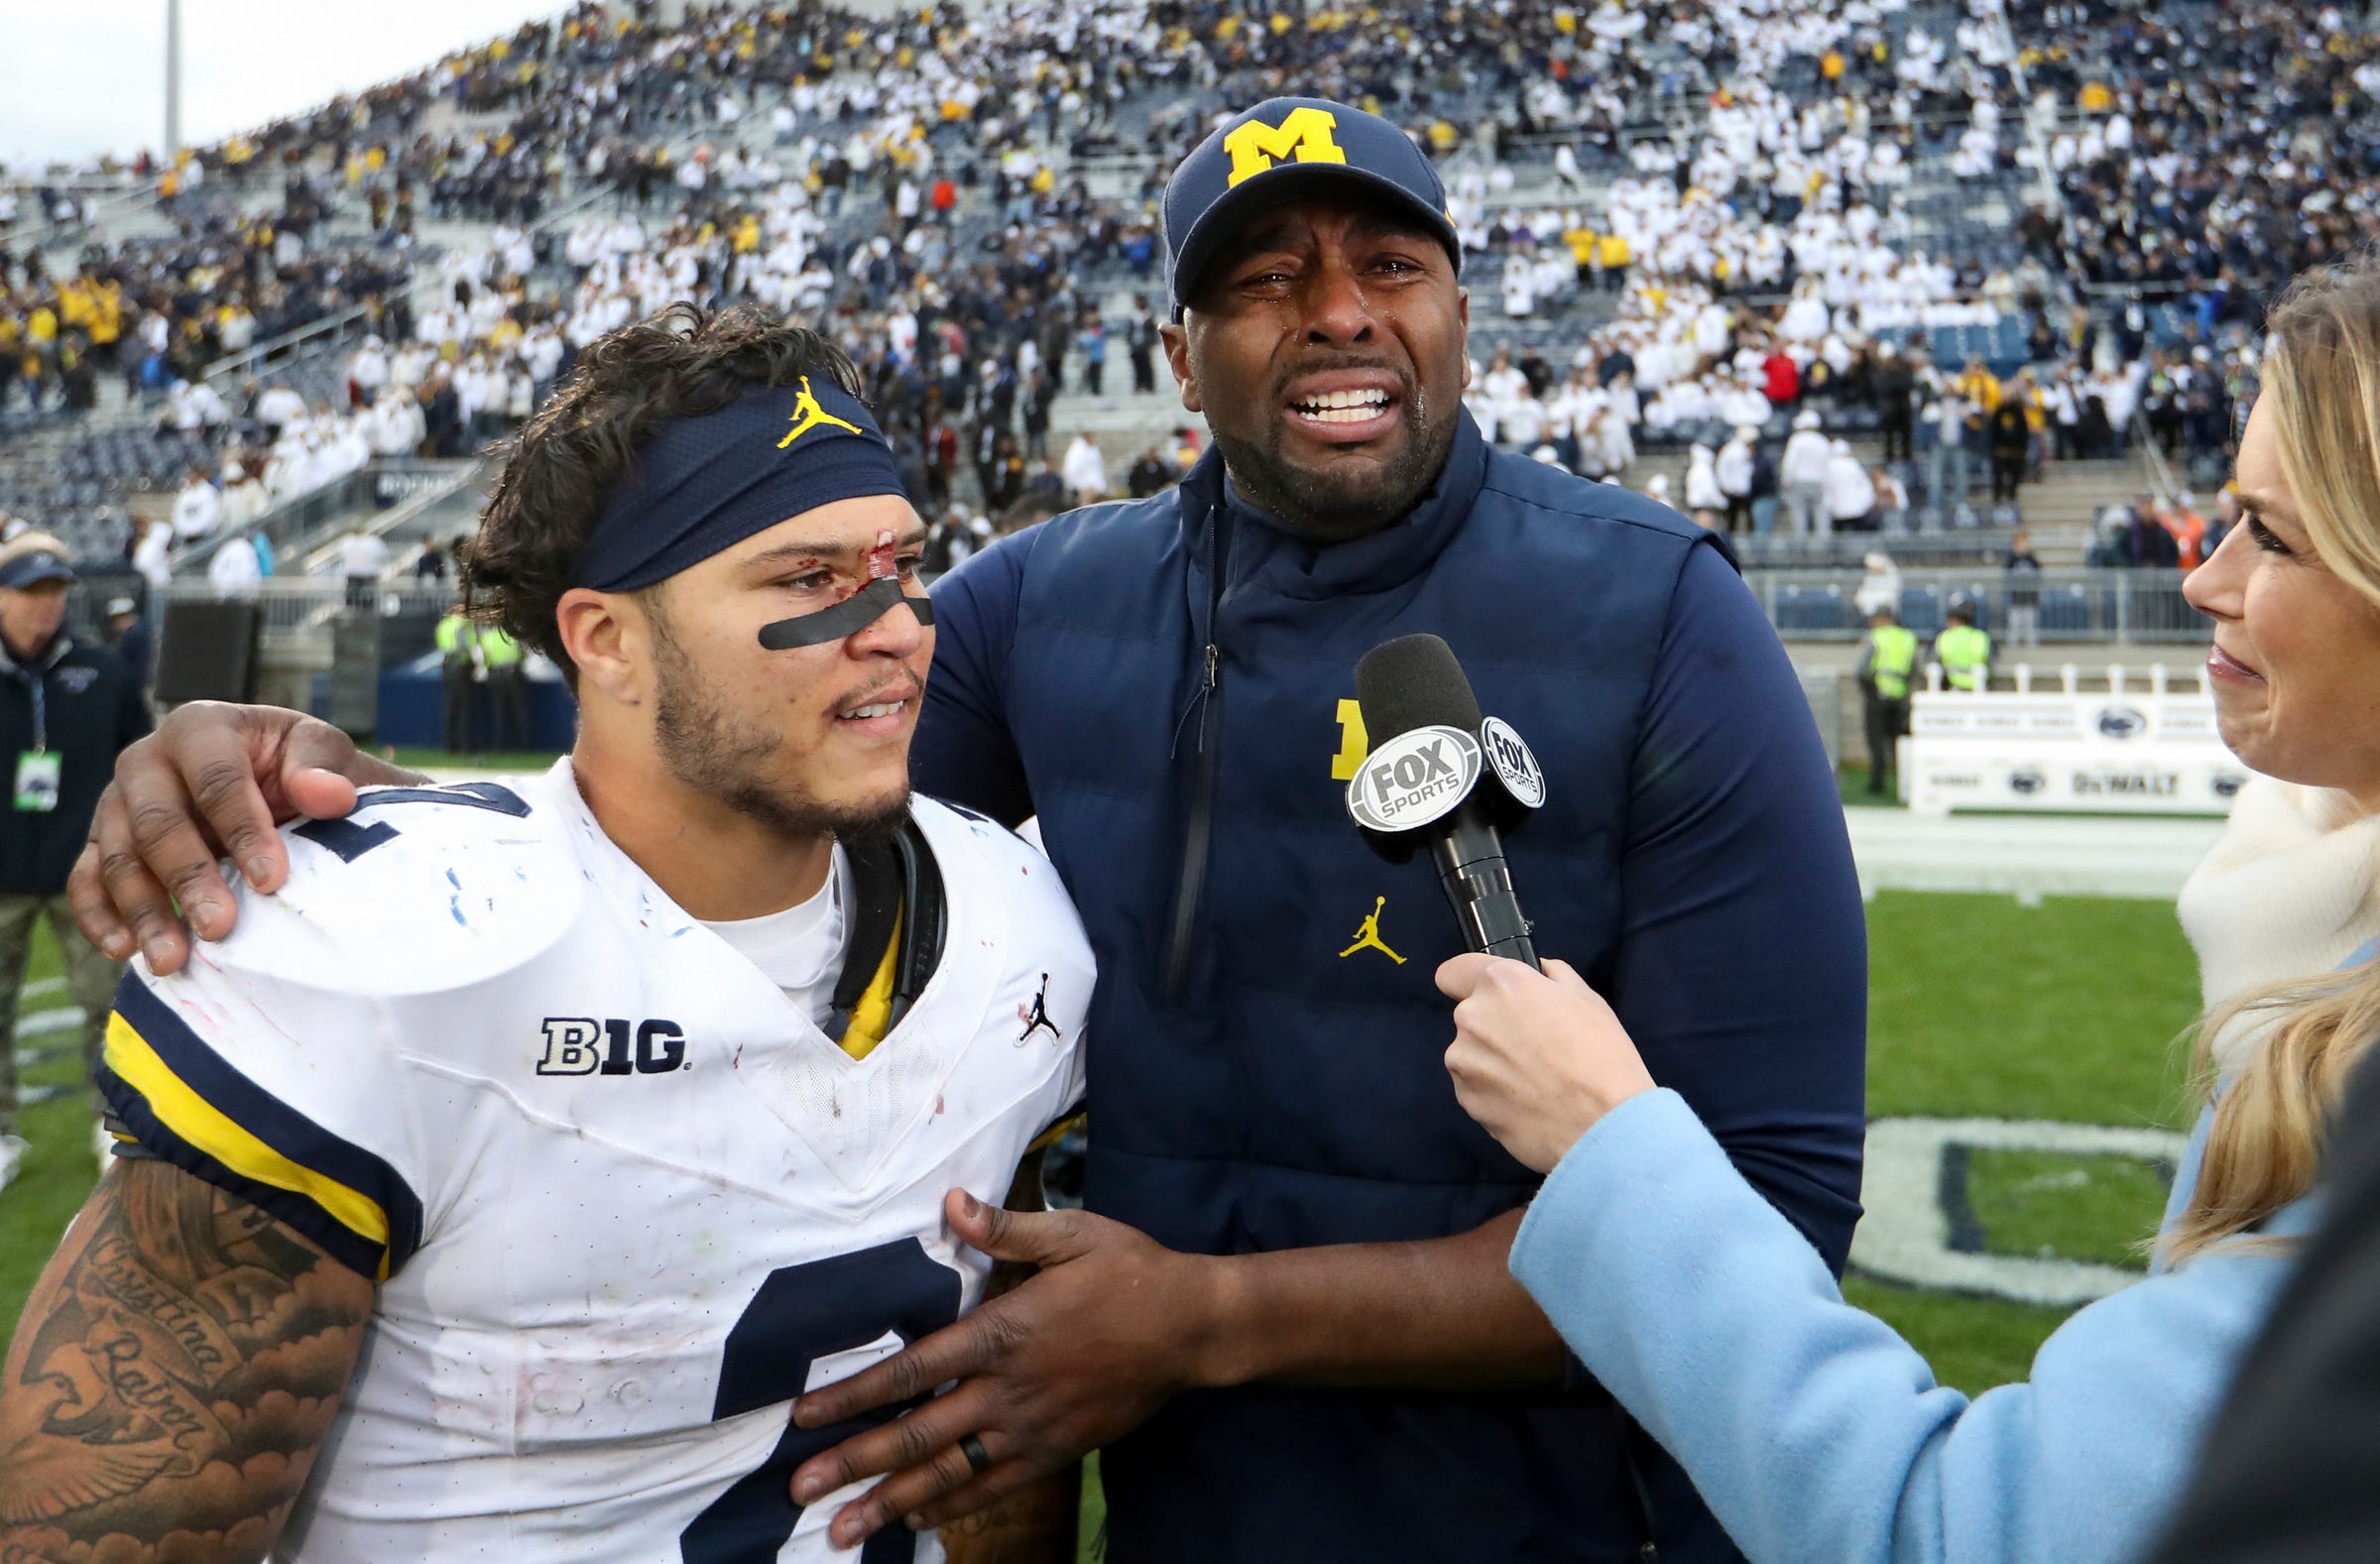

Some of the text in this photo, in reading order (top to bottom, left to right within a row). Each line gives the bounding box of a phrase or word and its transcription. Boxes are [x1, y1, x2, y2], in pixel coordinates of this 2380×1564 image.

[1223, 106, 1347, 188] M
[1370, 738, 1454, 804] FOX
[1490, 730, 1531, 779] FOX
[1381, 772, 1460, 818] SPORTS
[1503, 767, 1538, 793] SPORTS
